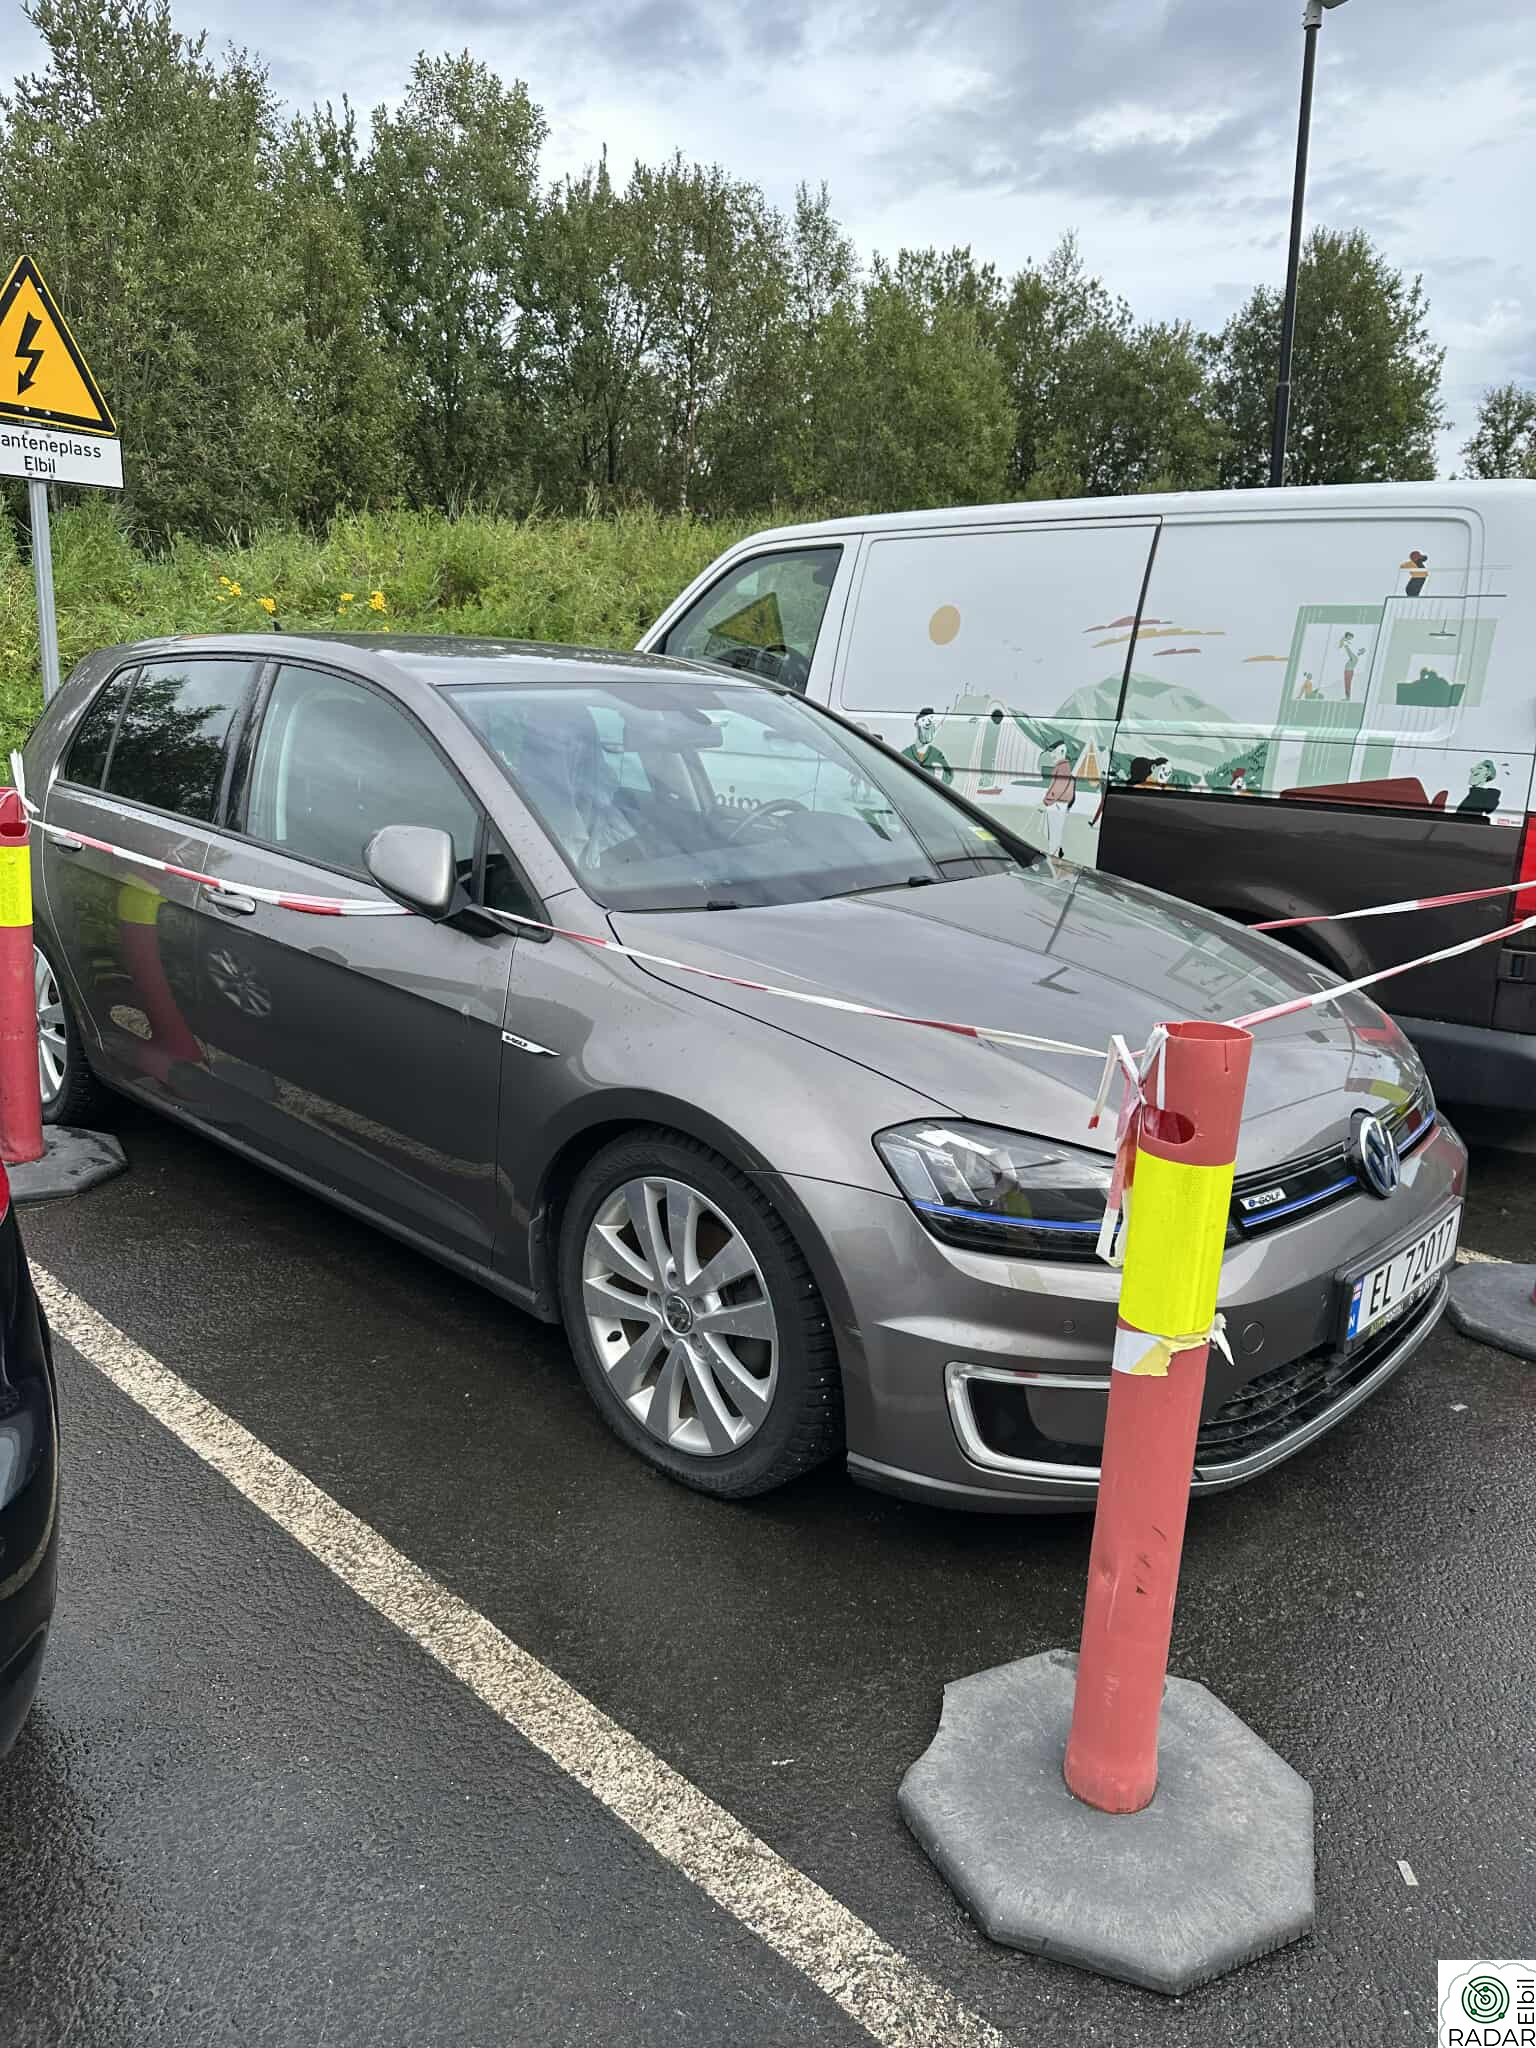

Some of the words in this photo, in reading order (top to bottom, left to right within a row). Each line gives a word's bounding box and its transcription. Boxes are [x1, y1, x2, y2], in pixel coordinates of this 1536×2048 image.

[0, 434, 101, 458] anteneplass
[24, 456, 56, 473] Elbil
[1369, 1264, 1392, 1316] EL
[1400, 1216, 1455, 1293] 72017
